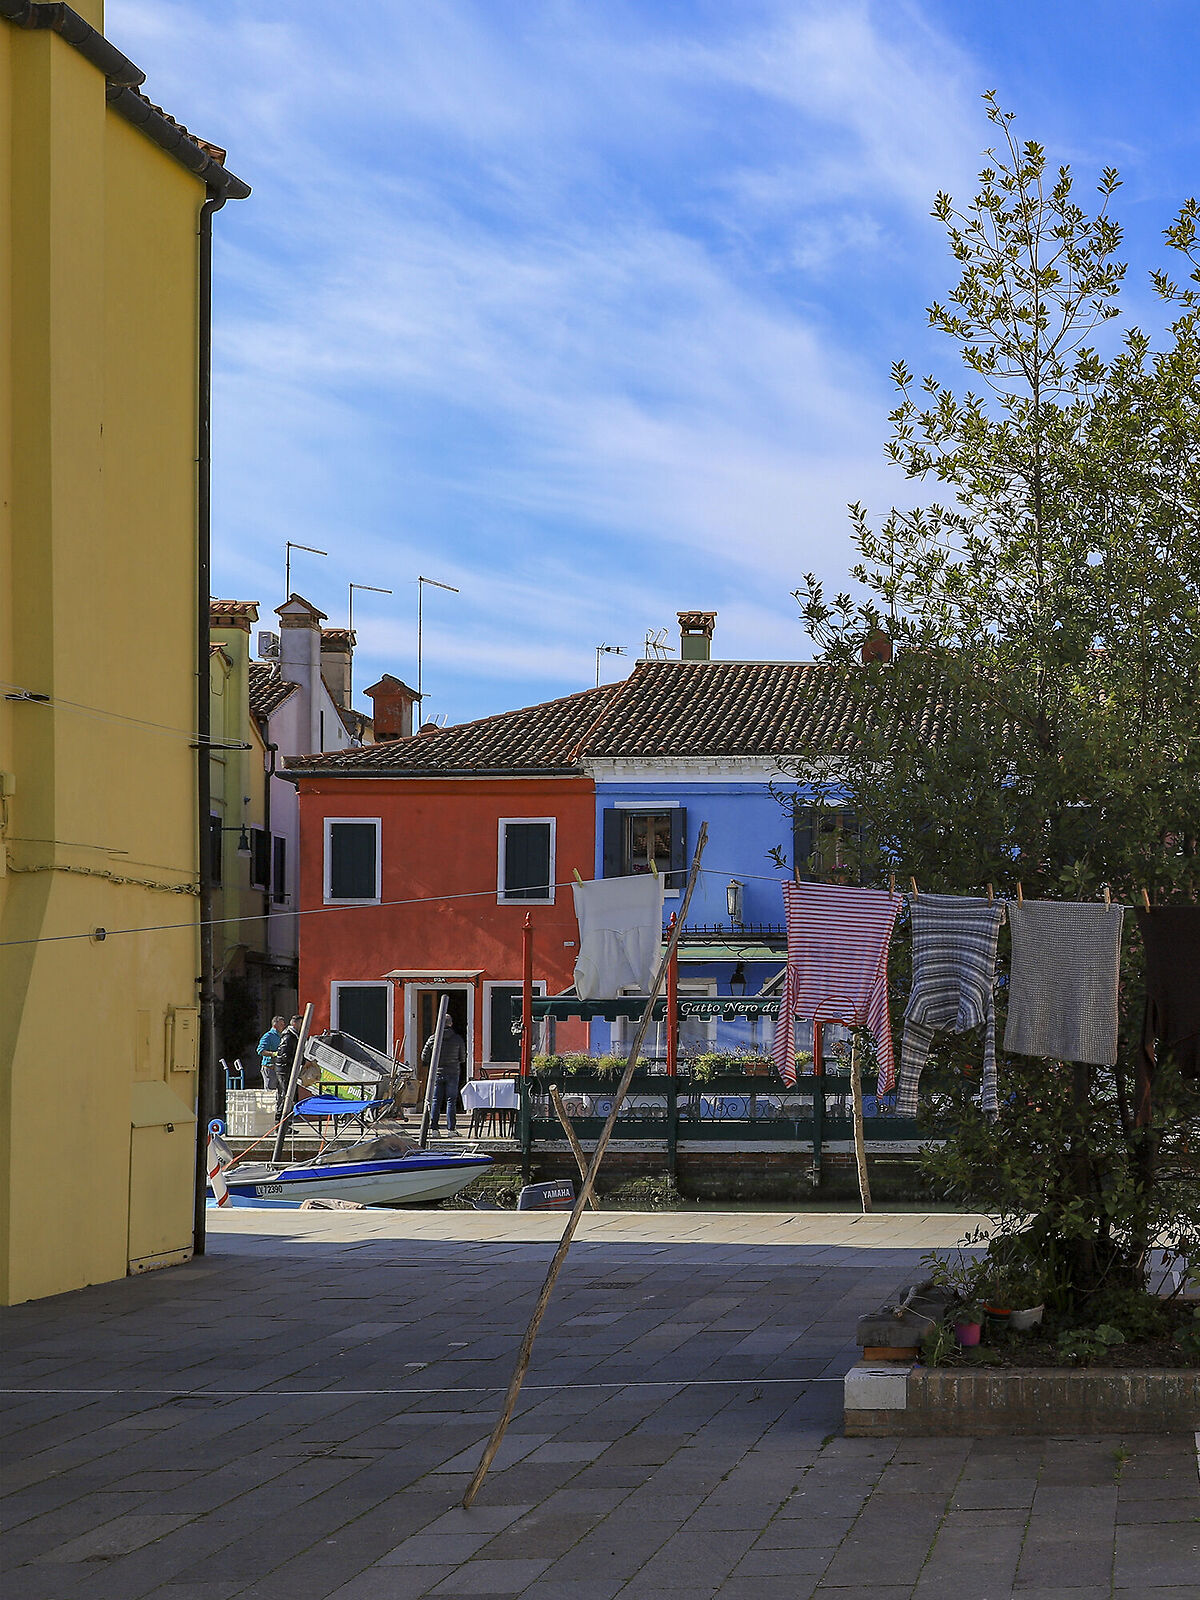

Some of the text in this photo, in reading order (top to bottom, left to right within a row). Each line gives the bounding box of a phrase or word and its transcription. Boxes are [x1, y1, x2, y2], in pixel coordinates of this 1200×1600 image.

[680, 1002, 721, 1016] Gatto
[723, 1002, 759, 1013] Nero
[761, 1001, 780, 1013] da
[542, 1188, 571, 1199] YAMAHA
